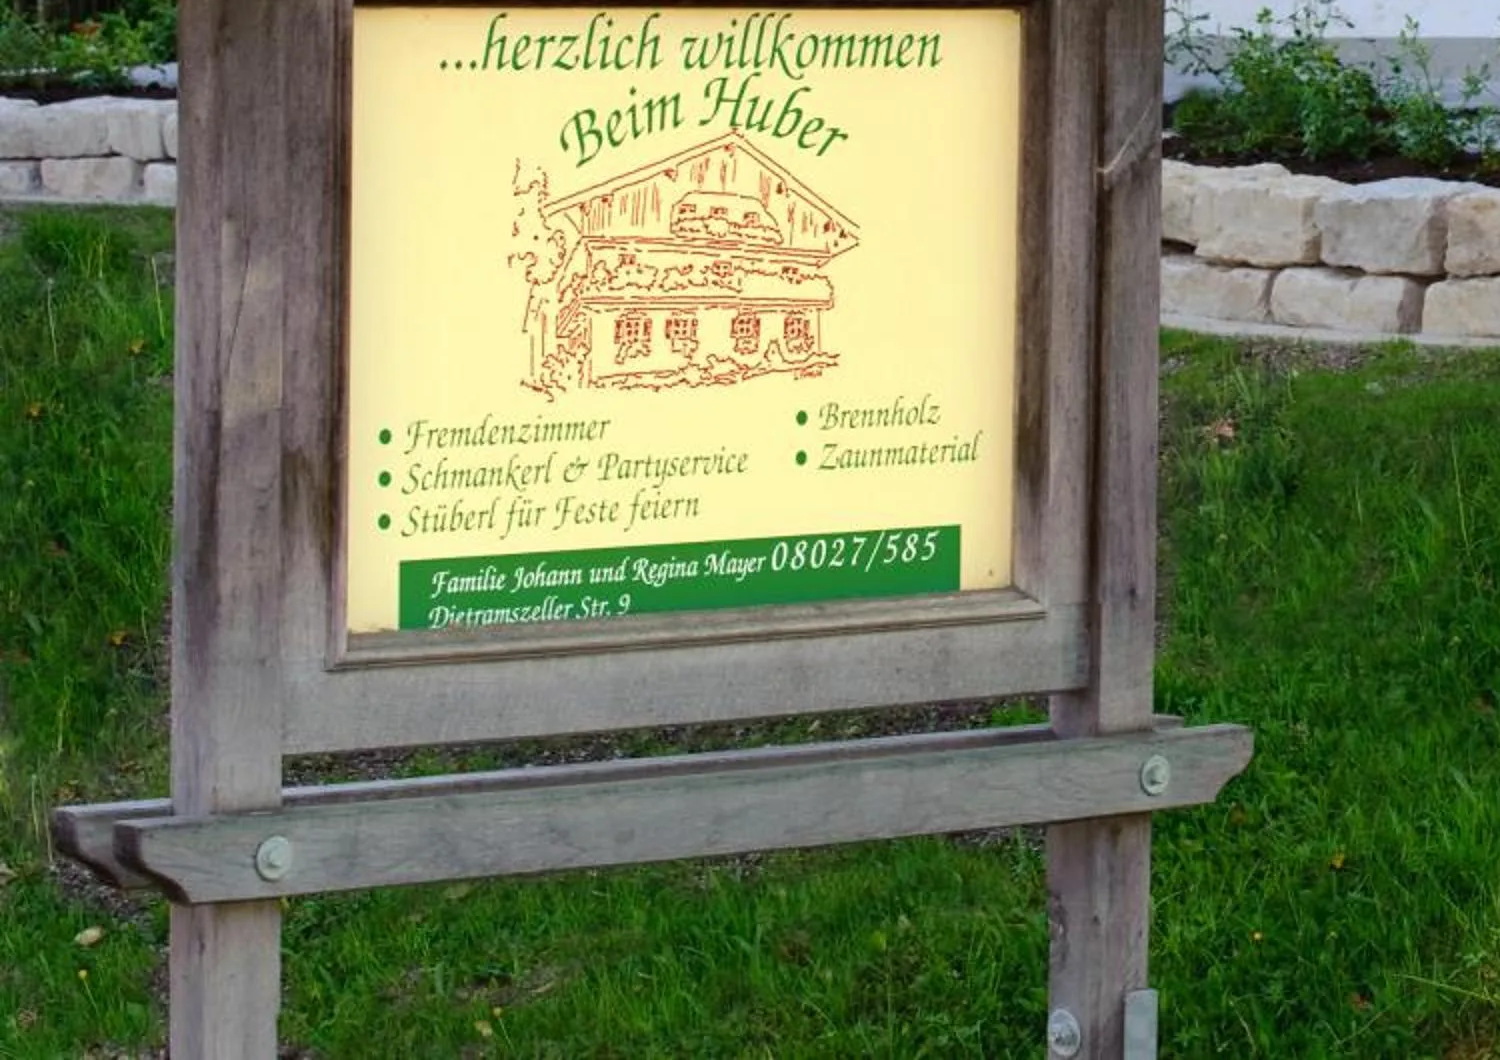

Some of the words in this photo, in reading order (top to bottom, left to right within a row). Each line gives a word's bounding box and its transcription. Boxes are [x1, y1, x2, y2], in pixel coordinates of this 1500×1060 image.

[683, 13, 943, 79] willkommen
[559, 89, 683, 168] Beim
[698, 72, 849, 157] Huber
[404, 413, 611, 455] Fremdenzimmer
[818, 393, 942, 430] Brennholz
[401, 451, 557, 495] Schmankerl
[562, 455, 589, 483] &
[597, 446, 750, 489] Partyservice
[817, 430, 983, 470] Zaunmaterial
[400, 495, 501, 537] Stüberl
[500, 495, 546, 540] für
[553, 494, 620, 530] Feste
[624, 487, 700, 532] feiern
[430, 565, 506, 599] Familie
[510, 561, 583, 593] Johann
[589, 556, 630, 584] und
[632, 555, 698, 588] Regina
[703, 549, 766, 582] Mayer
[771, 530, 942, 573] 08027/585
[427, 595, 574, 630] Dietramszeller
[575, 595, 612, 621] Str.
[617, 593, 631, 617] 9
